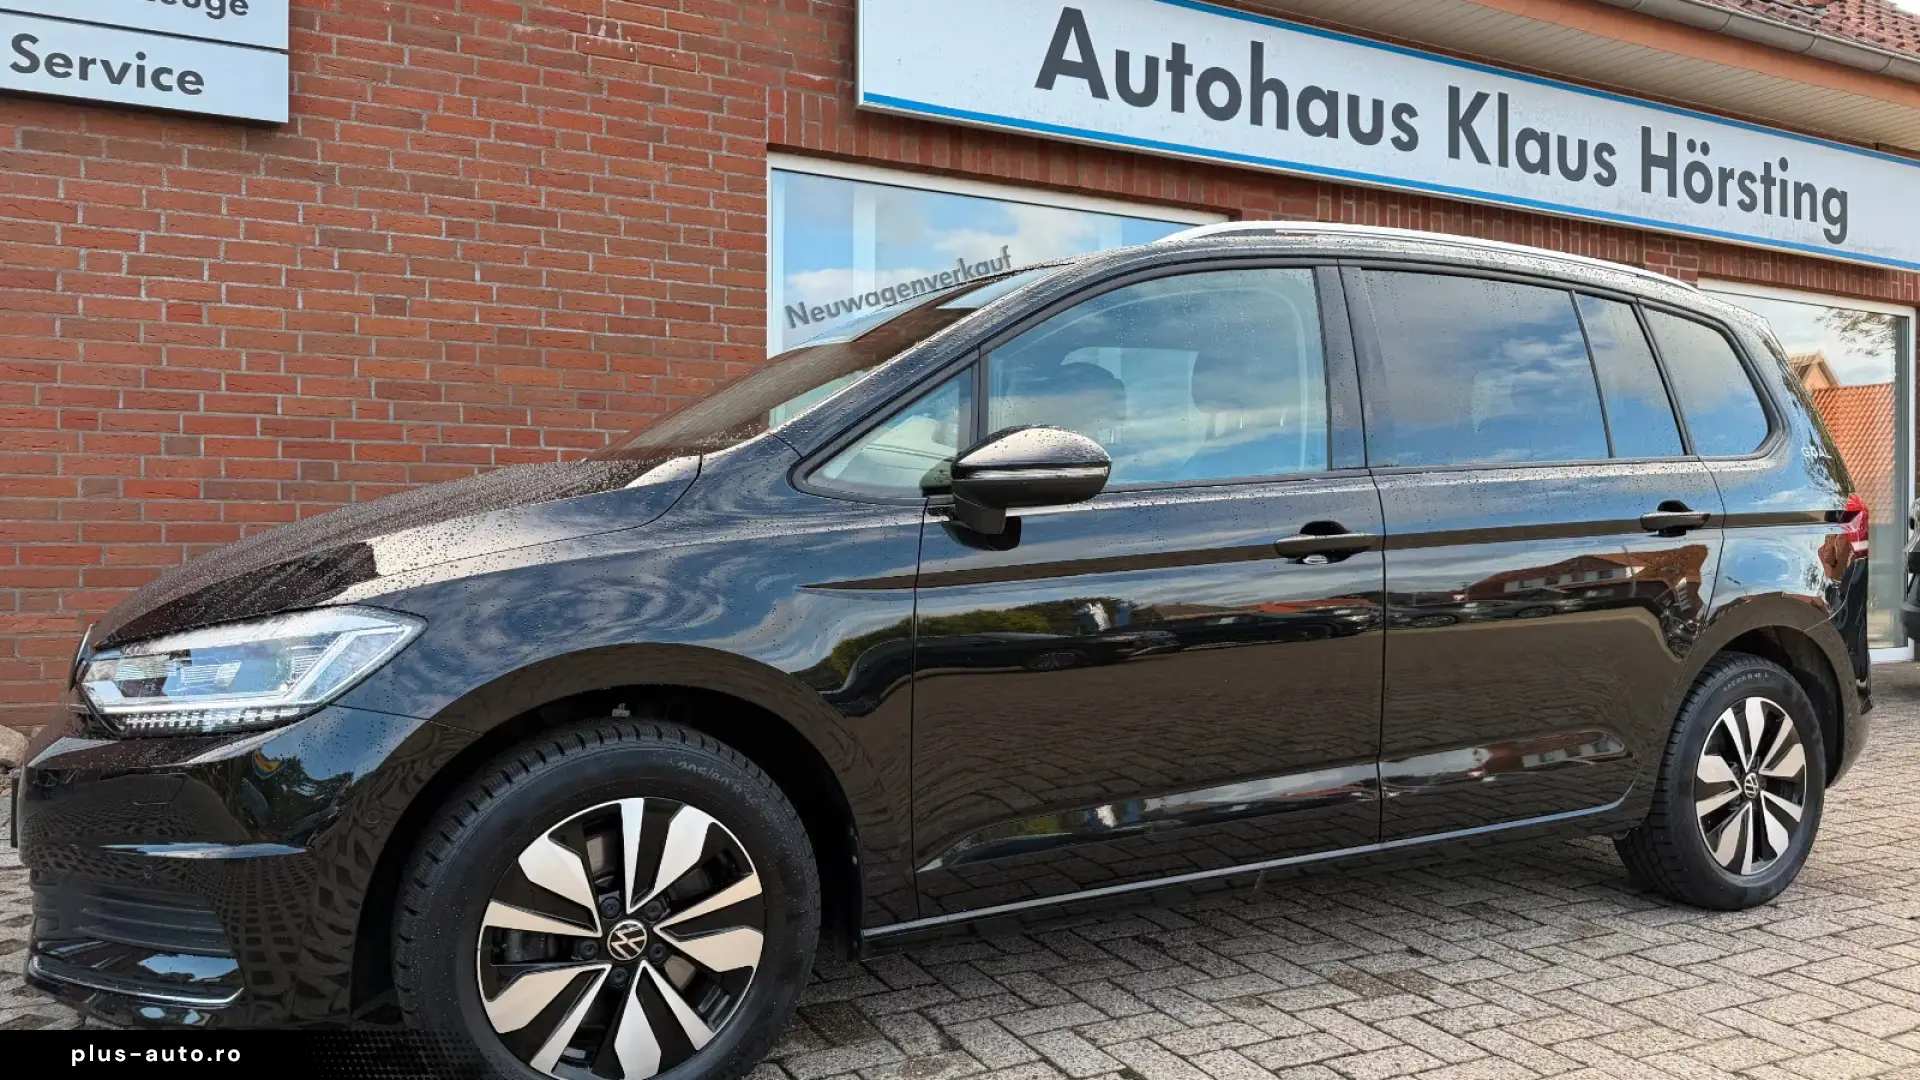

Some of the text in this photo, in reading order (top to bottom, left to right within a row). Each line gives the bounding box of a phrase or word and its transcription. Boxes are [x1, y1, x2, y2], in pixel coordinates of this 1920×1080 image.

[9, 33, 205, 96] Service
[1034, 6, 1848, 245] Autohaus Klaus Hörsting
[784, 245, 1012, 329] Neuwagenverkauf
